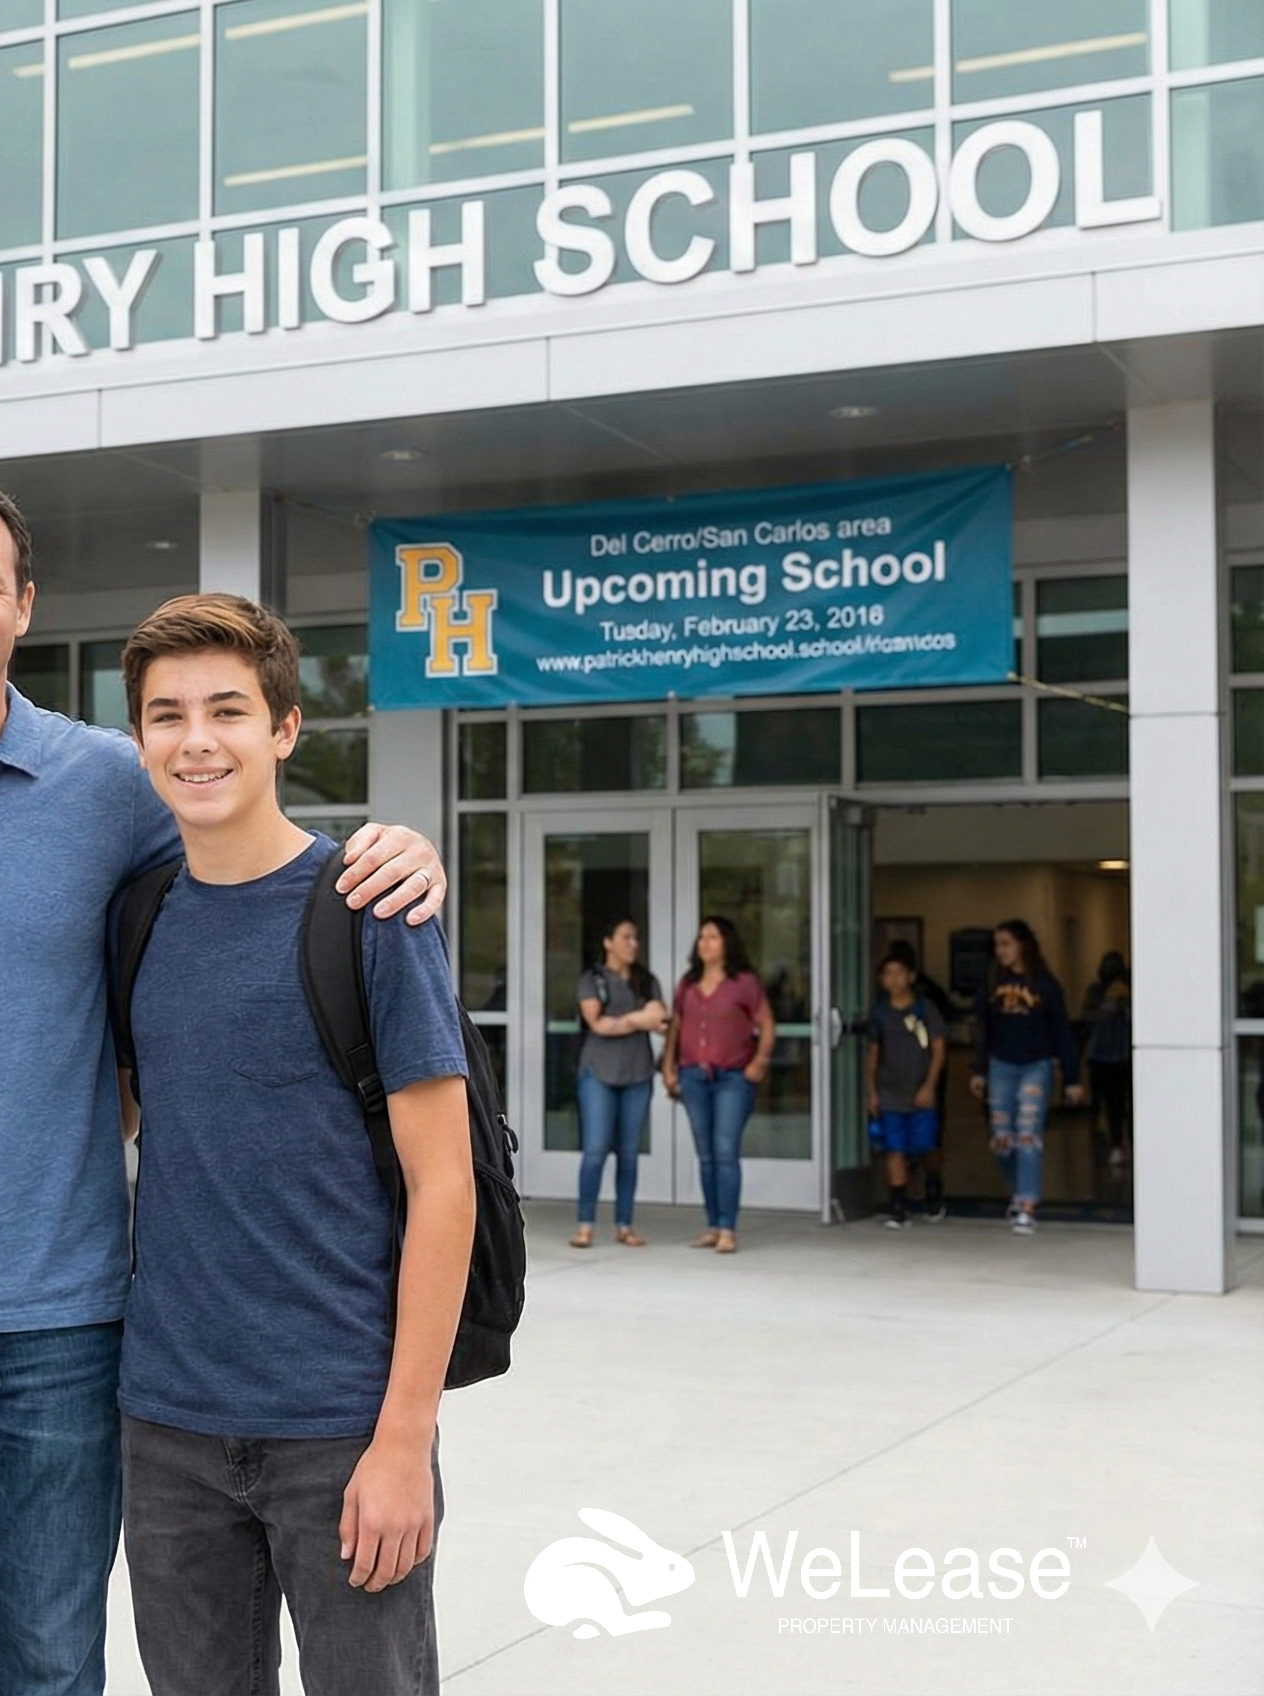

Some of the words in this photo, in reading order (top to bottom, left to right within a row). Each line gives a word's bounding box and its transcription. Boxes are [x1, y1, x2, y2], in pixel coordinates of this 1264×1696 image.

[193, 200, 486, 341] HIGH
[532, 109, 1163, 297] SCHOOL
[590, 533, 627, 557] Del
[633, 526, 748, 554] Cerro/San
[754, 520, 831, 546] Carlos
[837, 516, 892, 539] area
[542, 558, 767, 615] Upcoming
[781, 540, 946, 592] School
[684, 614, 779, 638] February
[785, 609, 820, 632] 23,
